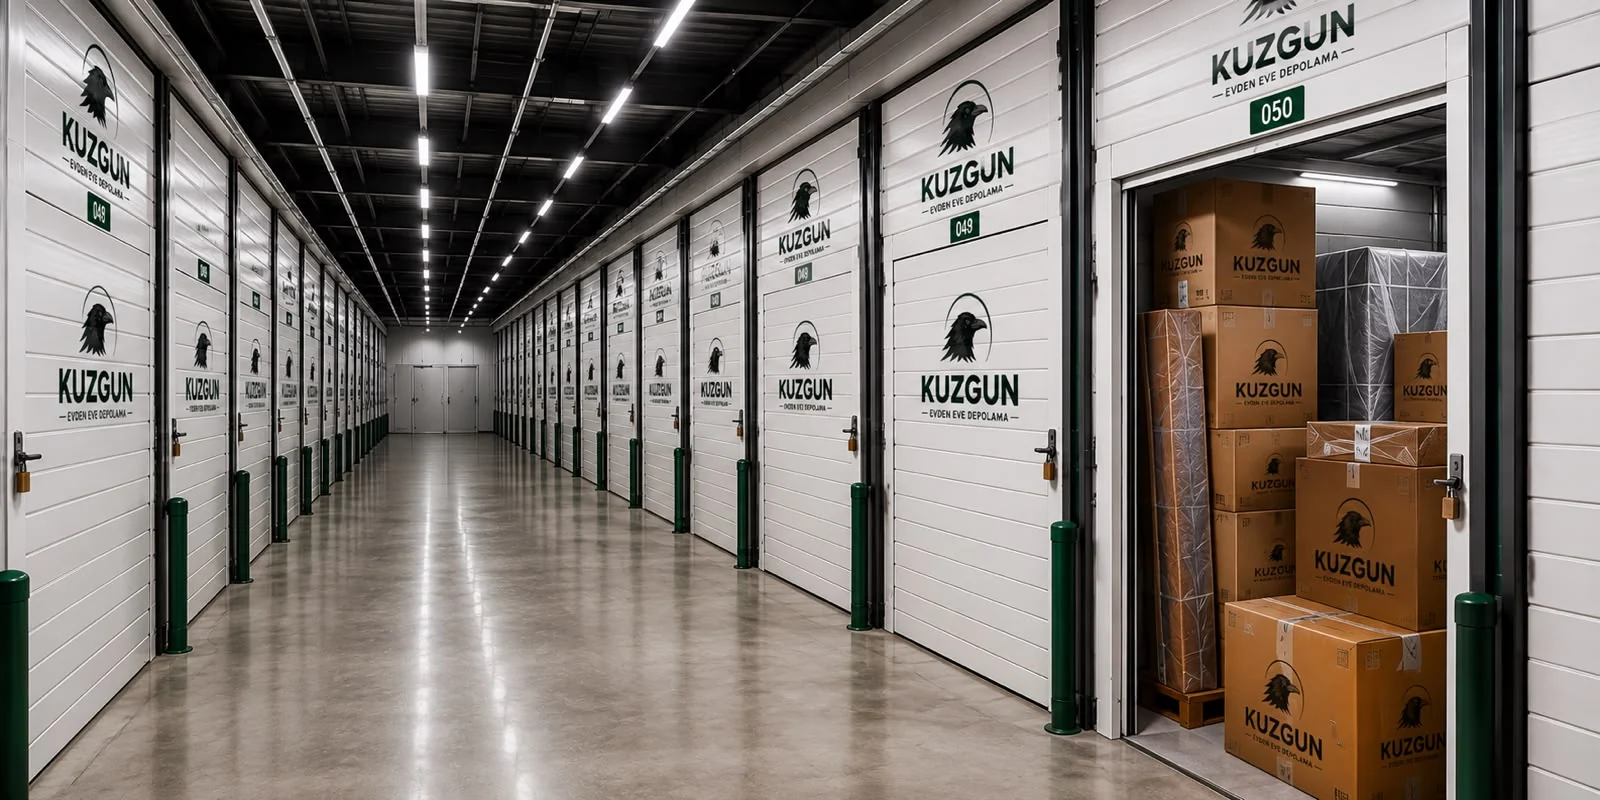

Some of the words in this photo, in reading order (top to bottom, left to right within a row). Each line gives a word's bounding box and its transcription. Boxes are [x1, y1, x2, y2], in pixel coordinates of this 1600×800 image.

[1212, 3, 1355, 85] KUZGUN
[1225, 78, 1256, 97] EVDEN
[1258, 71, 1276, 86] EVE
[1279, 50, 1339, 78] DEPOLAMA
[1261, 96, 1293, 125] 050
[62, 111, 130, 189] KUZGUN
[921, 146, 1014, 203] KUZGUN
[930, 201, 951, 215] EVDEN
[952, 197, 964, 208] EVE
[965, 185, 1003, 204] DEPOLAMA
[779, 218, 831, 255] KUZGUN
[955, 218, 973, 237] 049
[1161, 254, 1203, 271] KUZGUN
[1233, 255, 1300, 273] KUZGUN
[59, 368, 133, 403] KUZGUN
[186, 377, 219, 400] KUZGUN
[701, 381, 732, 398] KUZGUN
[779, 378, 832, 400] KUZGUN
[921, 374, 1018, 406] KUZGUN
[1236, 382, 1302, 398] KUZGUN
[1403, 385, 1447, 396] KUZGUN
[929, 409, 951, 419] EVDEN
[952, 410, 966, 420] EVE
[967, 411, 1009, 422] DEPOLAMA
[1315, 550, 1395, 587] KUZGUN
[1245, 706, 1322, 761] KUZGUN
